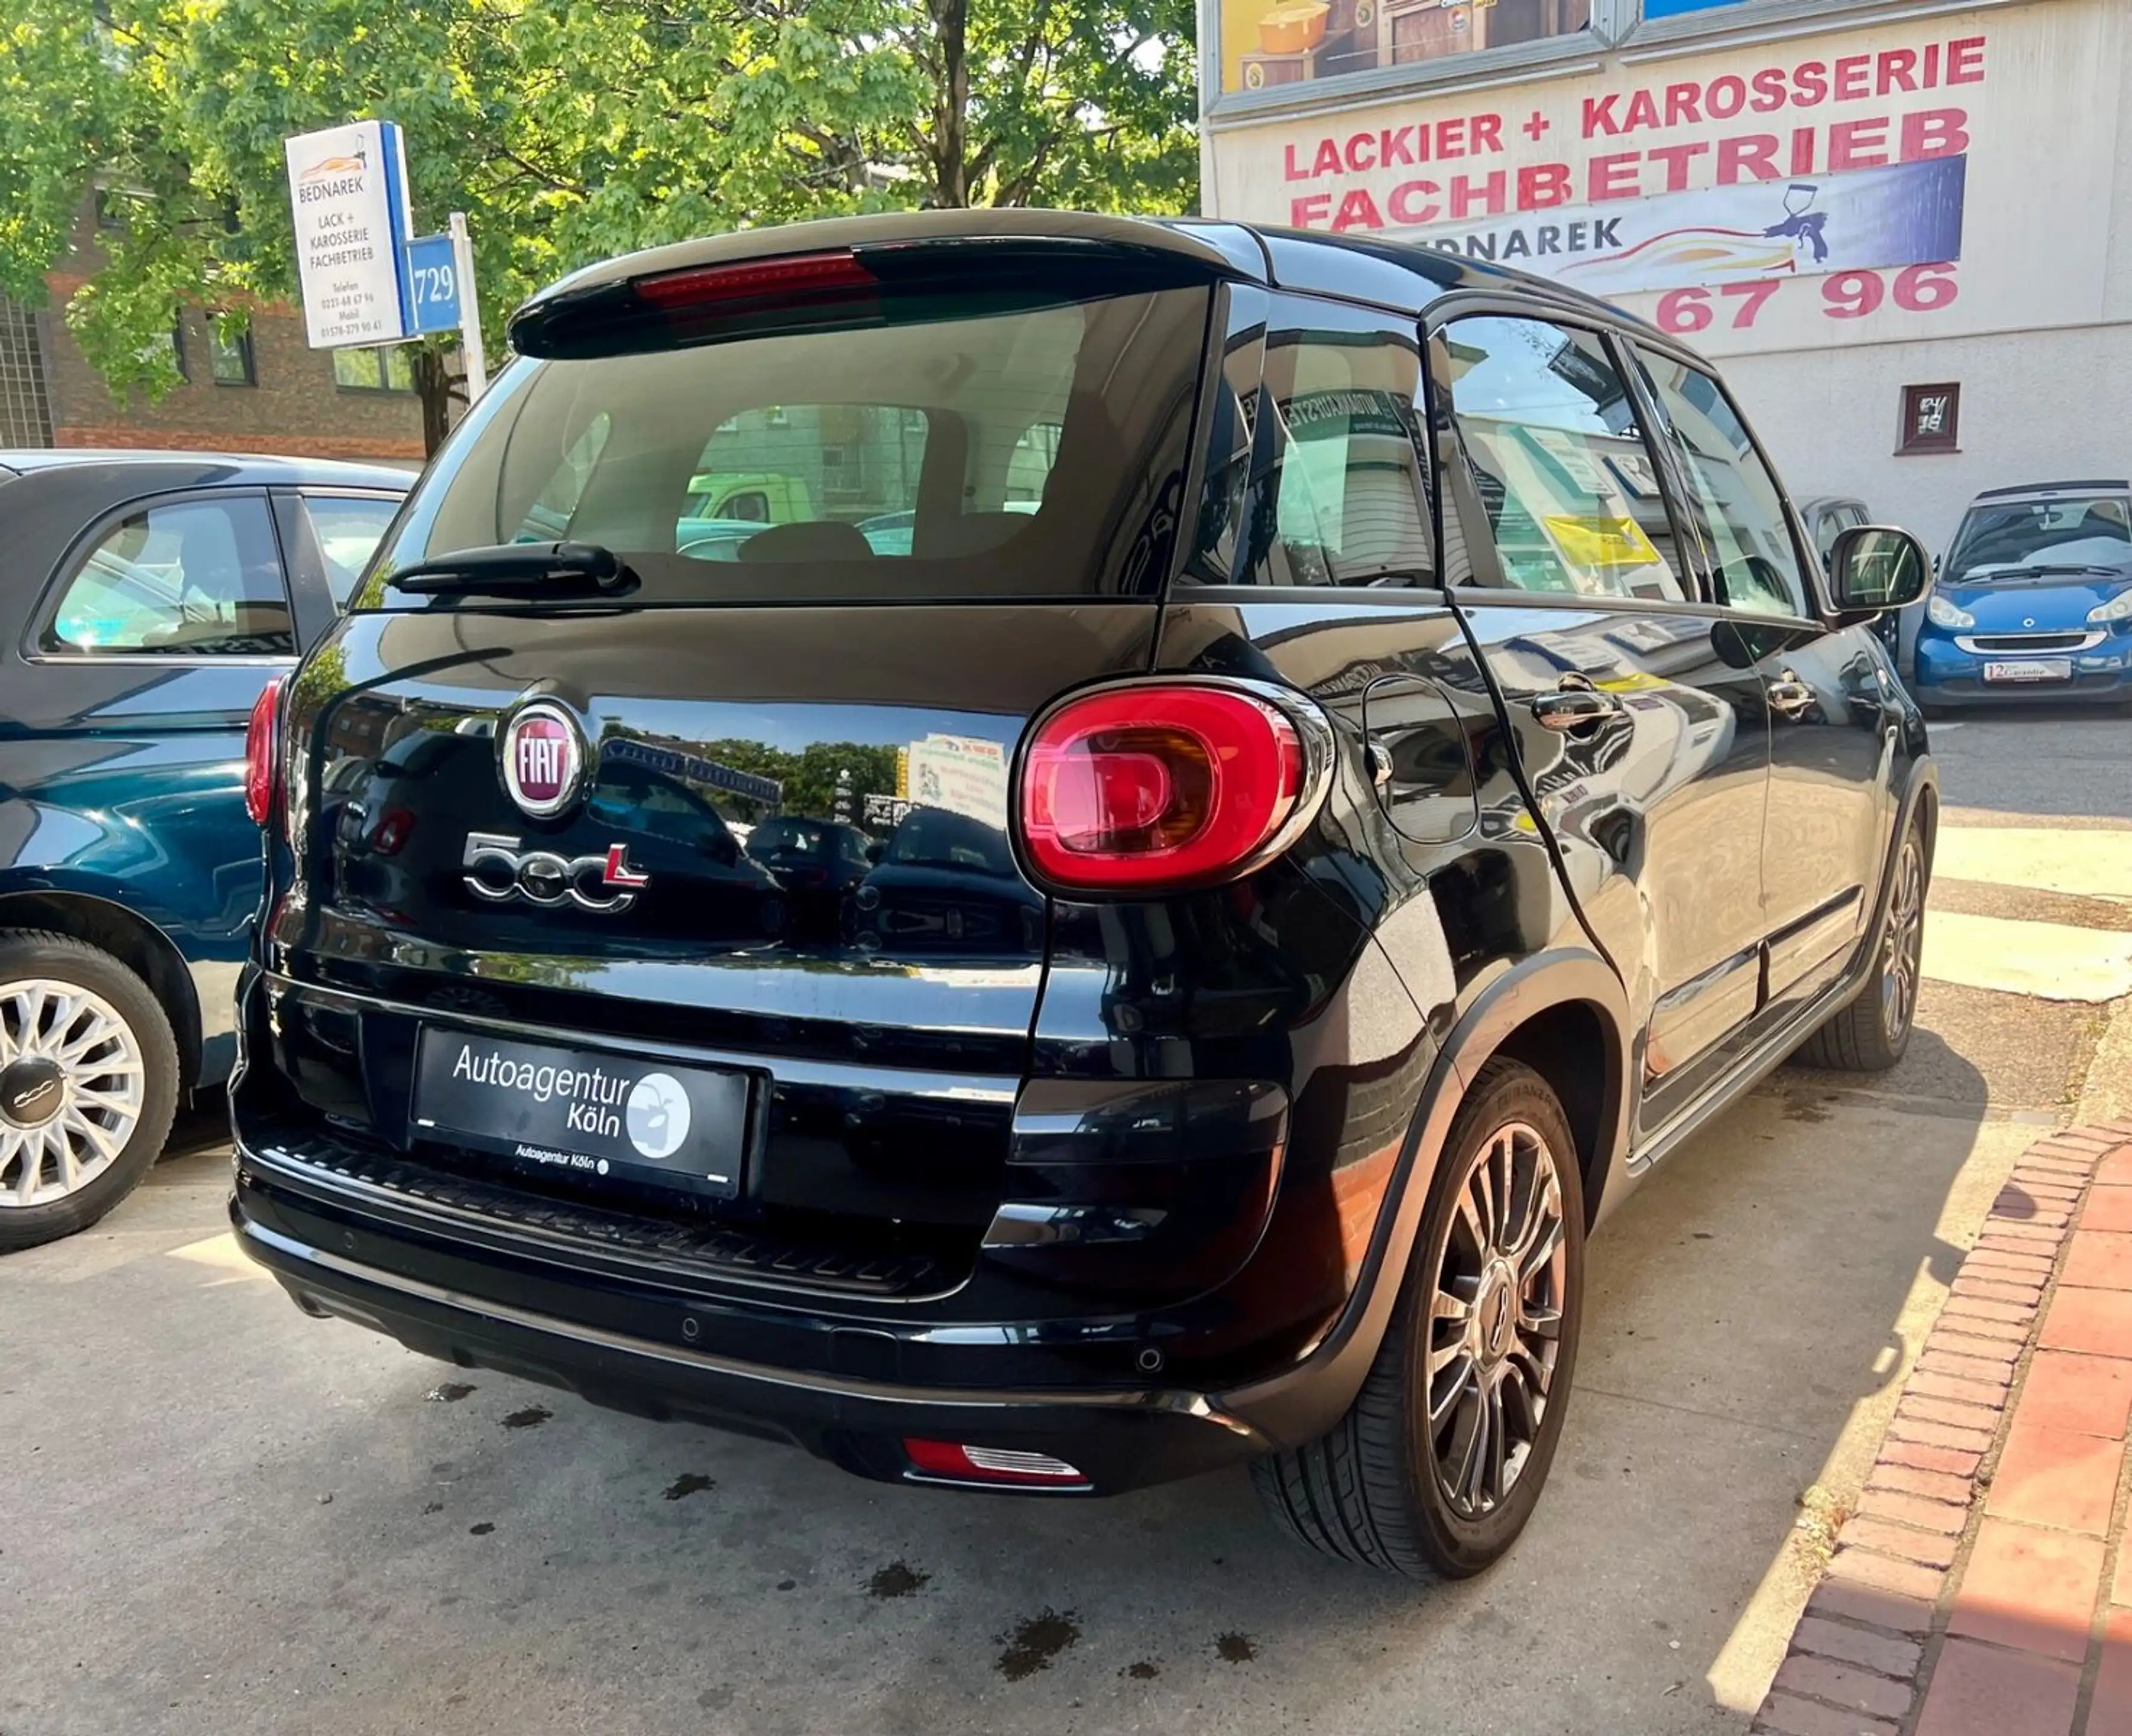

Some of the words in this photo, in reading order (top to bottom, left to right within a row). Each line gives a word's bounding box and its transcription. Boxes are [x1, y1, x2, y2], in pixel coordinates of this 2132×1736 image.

[1285, 113, 1504, 181] LACKIER
[1523, 111, 1550, 142] +
[1581, 36, 1987, 139] KAROSSERIE
[1291, 107, 1970, 234] FACHBETRIEB
[299, 177, 363, 204] BEDNAREK
[310, 227, 369, 251] KAROSSERIE
[318, 212, 344, 229] LACK
[1435, 216, 1623, 261] DNAREK
[310, 247, 374, 270] FACHBETRIEB
[333, 281, 359, 293] Telefon
[414, 265, 453, 304] 729
[1656, 279, 1781, 333] 67
[1821, 261, 1958, 318] 96
[519, 737, 563, 784] FIAT
[453, 1044, 630, 1105] Autoagentur
[567, 1101, 620, 1137] Köln
[515, 1144, 570, 1164] Autoagentur
[570, 1153, 595, 1169] Köln
